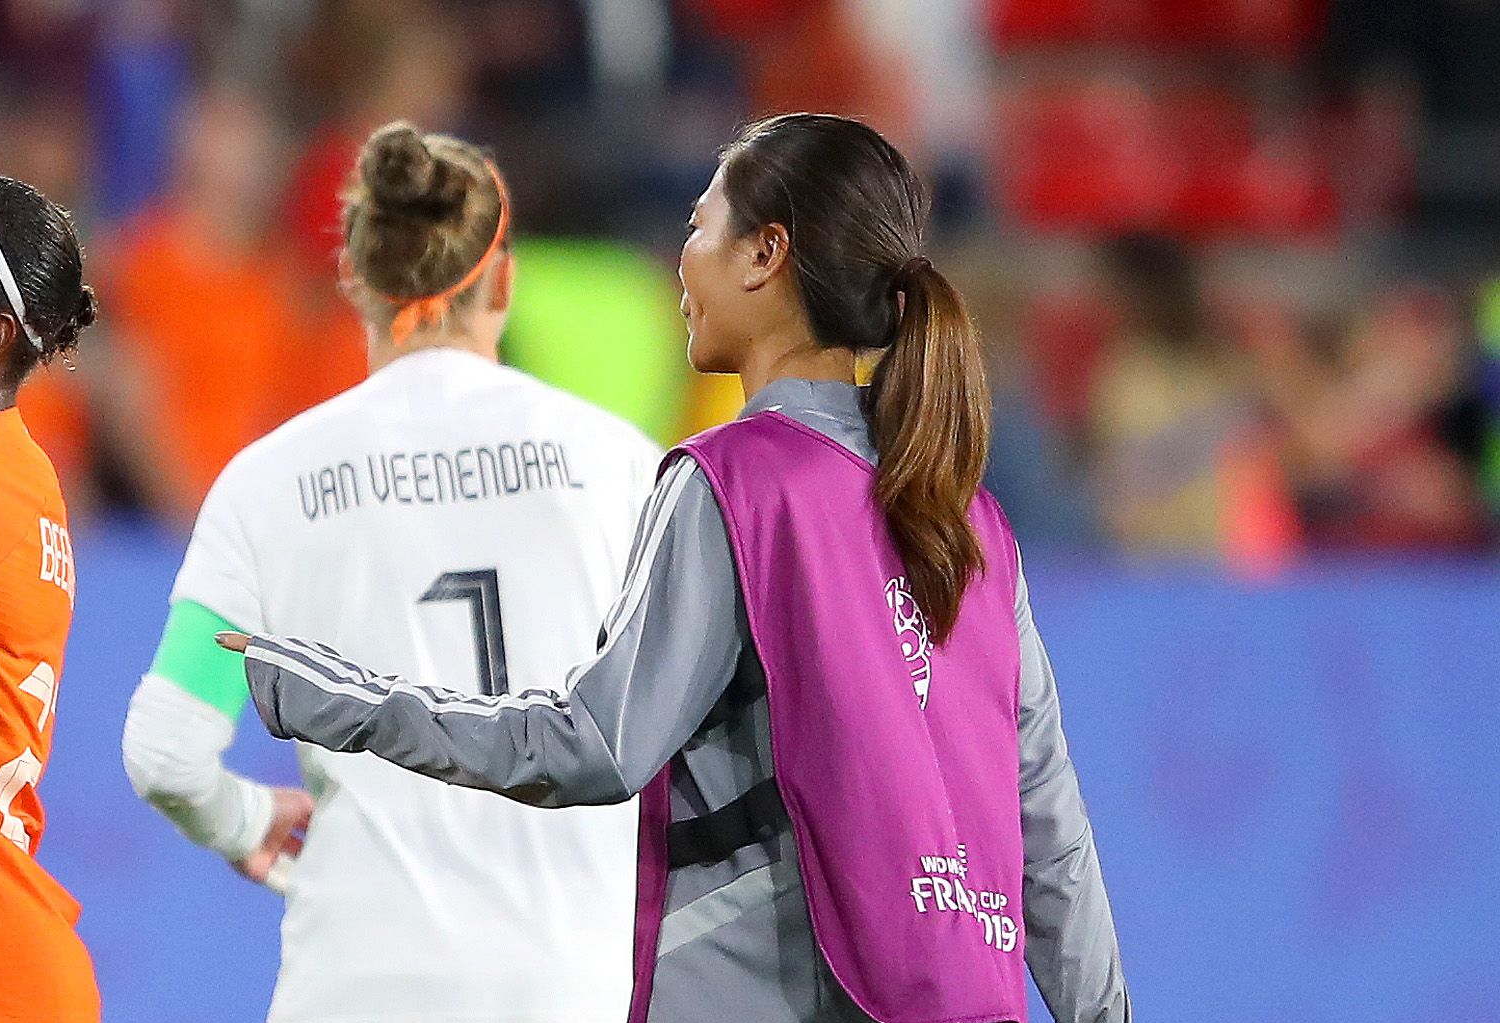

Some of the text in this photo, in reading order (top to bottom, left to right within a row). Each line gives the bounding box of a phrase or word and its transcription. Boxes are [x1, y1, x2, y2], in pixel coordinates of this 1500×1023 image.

[298, 440, 584, 521] VAN VEENENDAAL
[909, 876, 976, 915] FRA
[979, 890, 1009, 911] CUP
